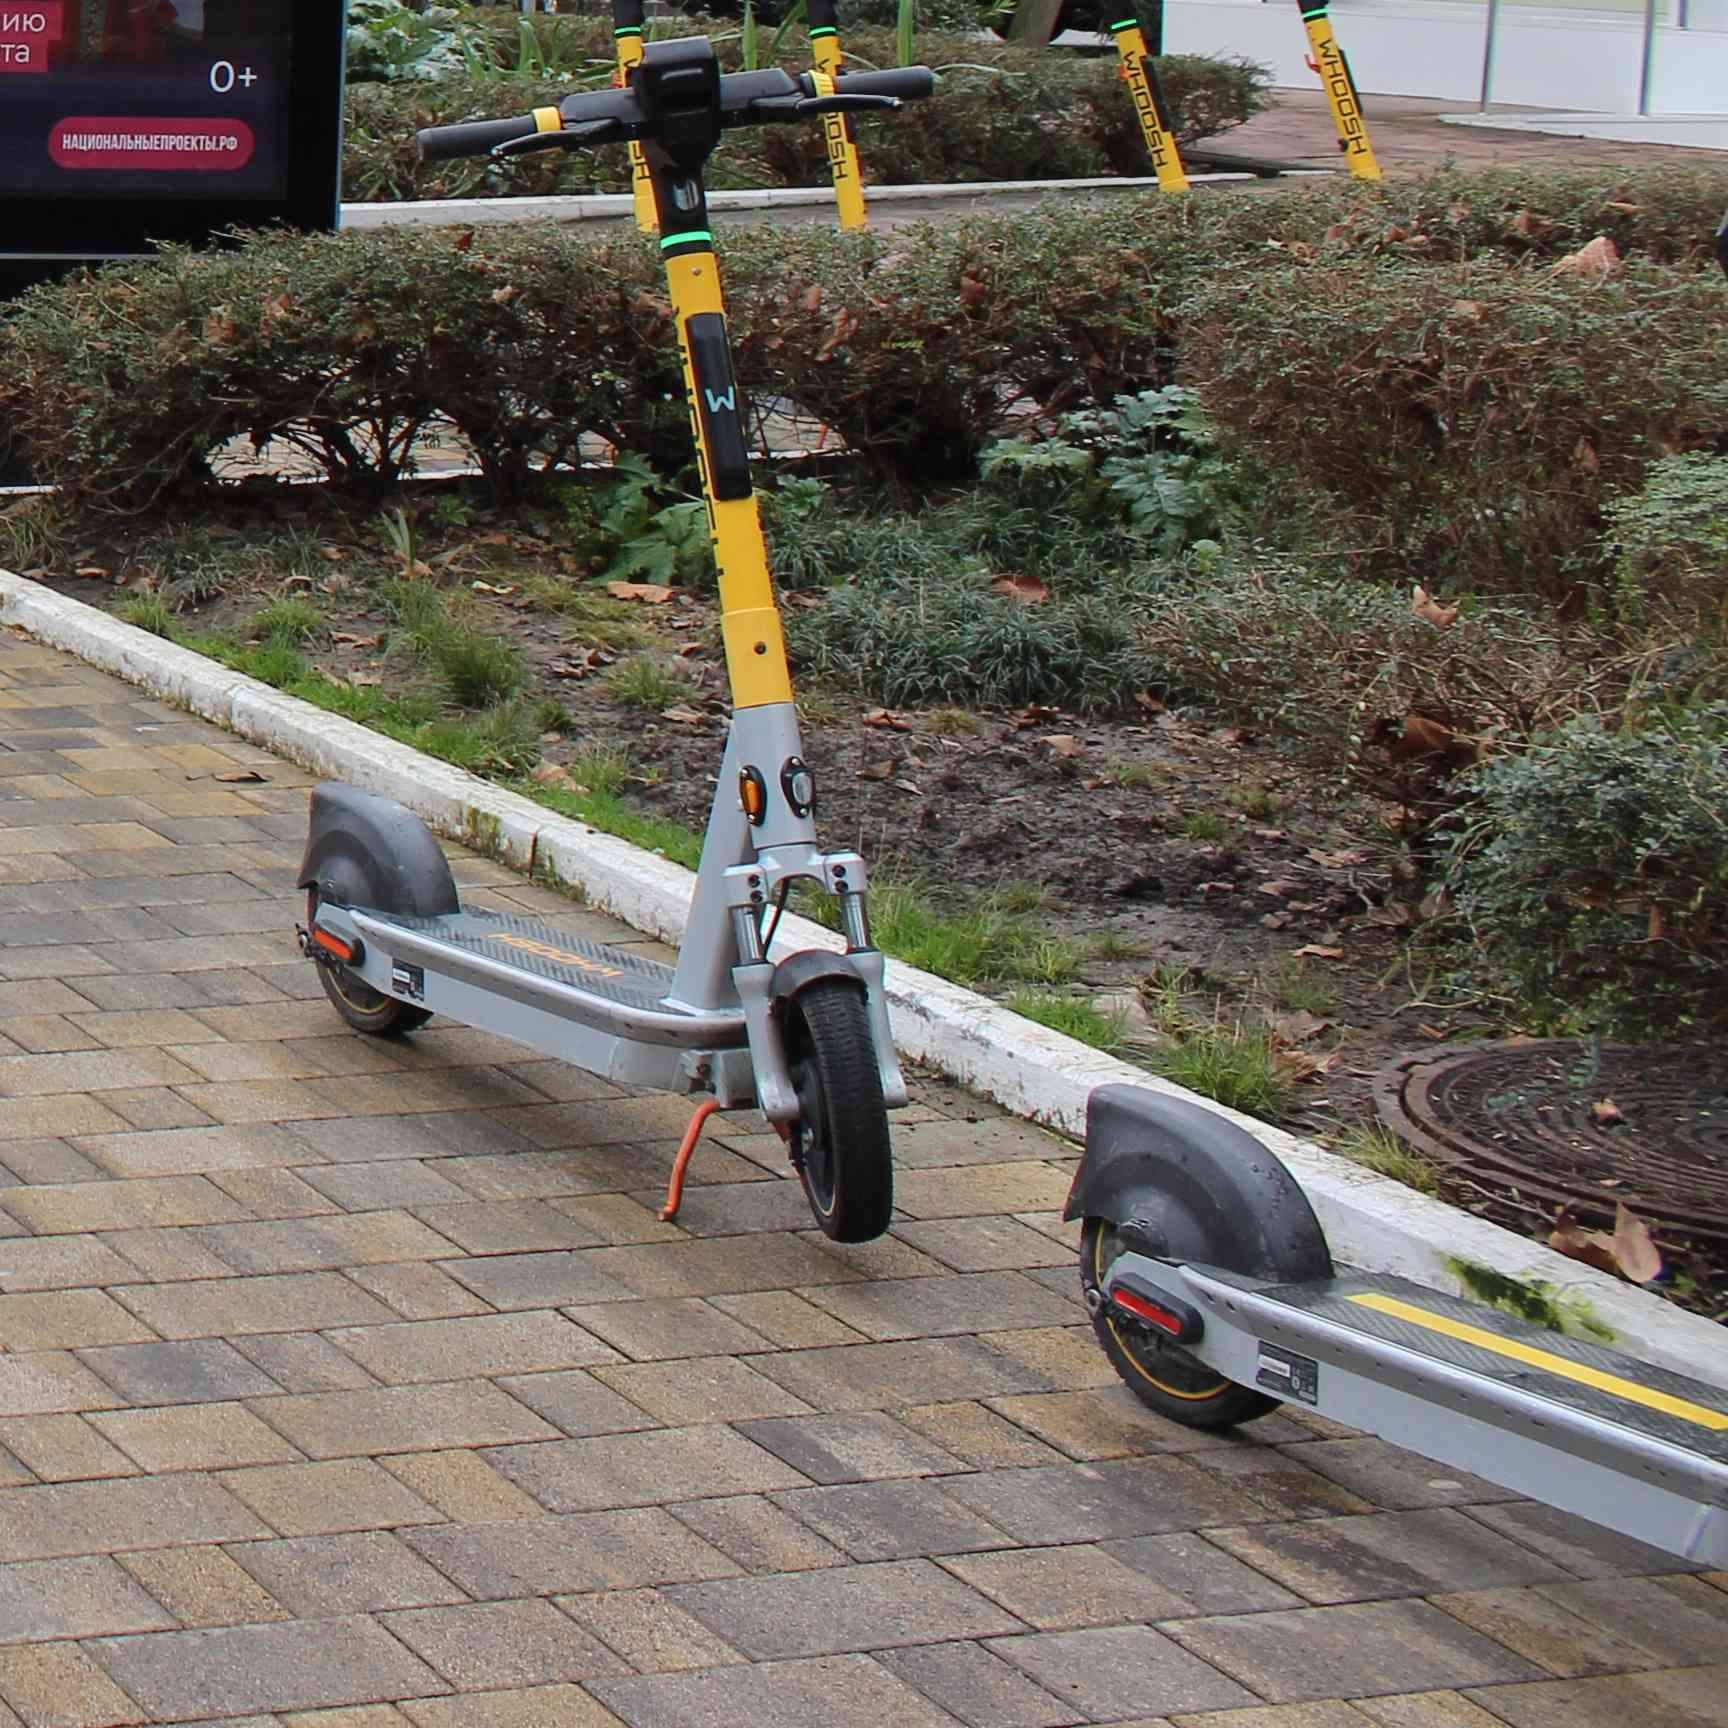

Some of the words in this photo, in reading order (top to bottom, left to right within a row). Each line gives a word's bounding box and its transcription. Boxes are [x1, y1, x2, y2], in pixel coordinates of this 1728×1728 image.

[209, 60, 258, 93] 0+
[1123, 51, 1168, 168] WHOOSH
[1319, 39, 1366, 155] WHOOSH
[62, 133, 237, 152] НАЦИОНАЛЬНЫЕПРОЕКТЫ.РФ
